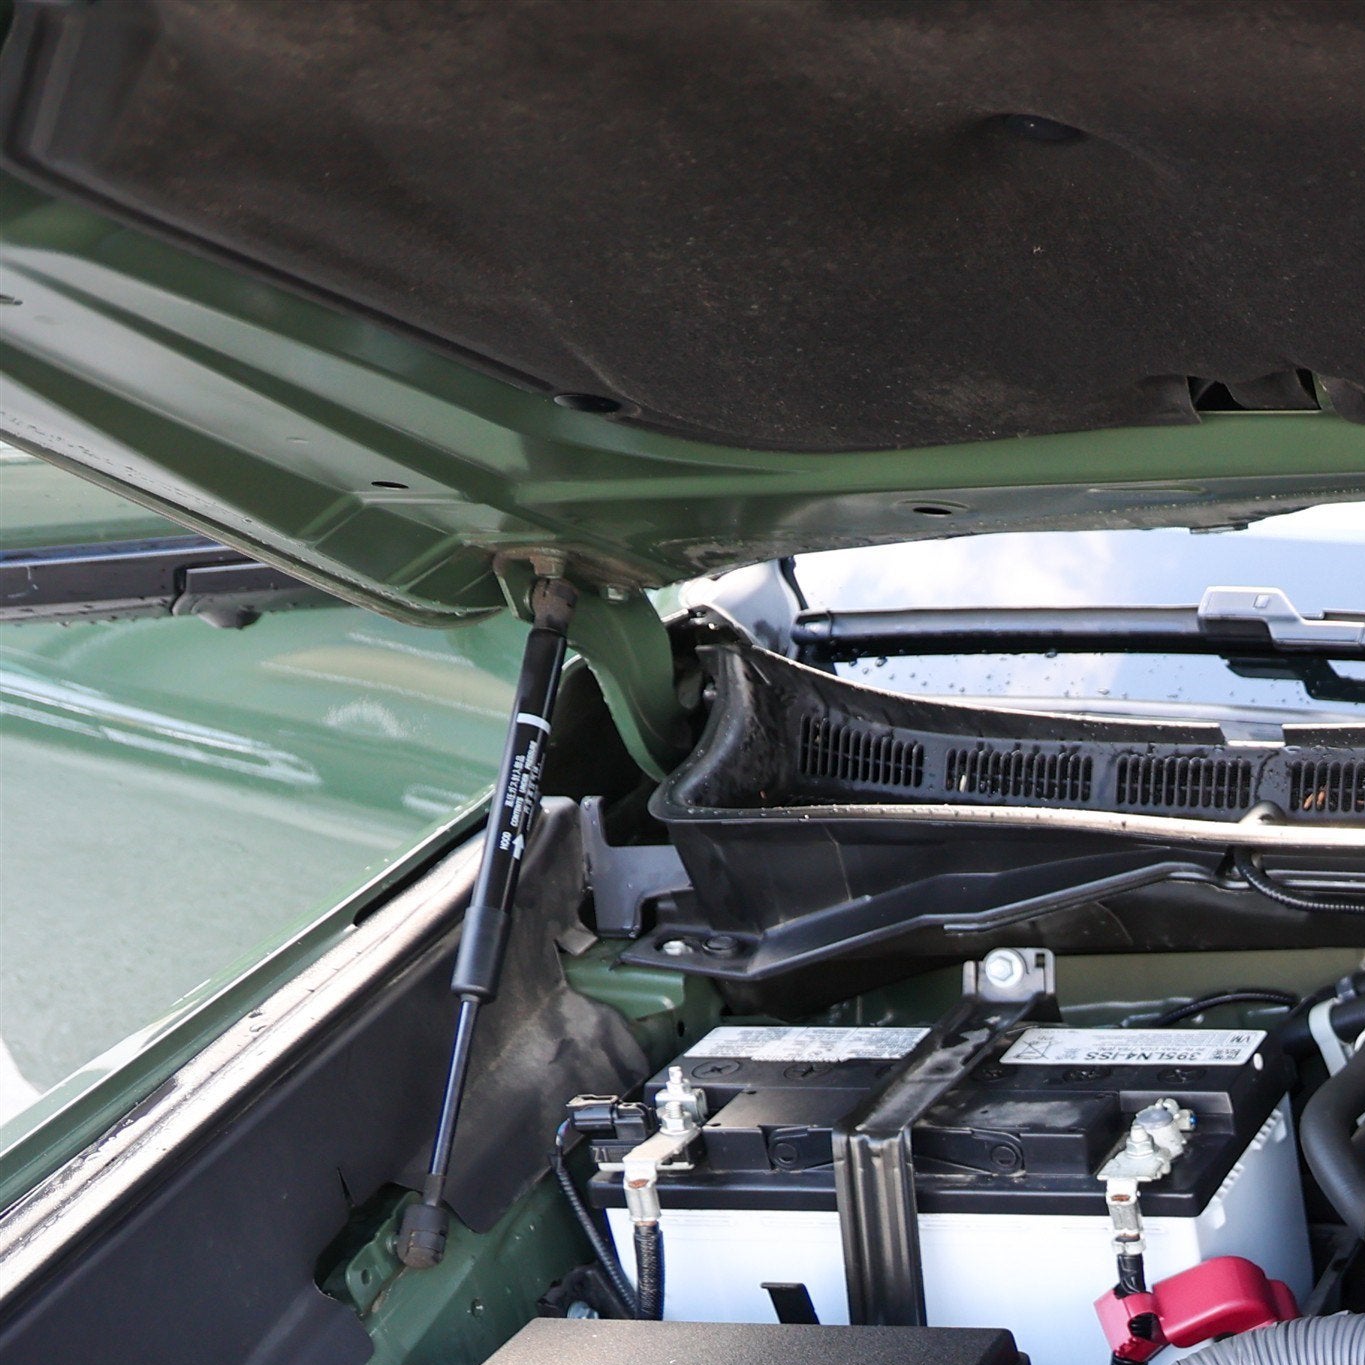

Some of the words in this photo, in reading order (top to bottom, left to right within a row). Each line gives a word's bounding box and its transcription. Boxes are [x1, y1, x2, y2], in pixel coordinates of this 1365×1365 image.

[509, 797, 524, 826] CONTENTS
[518, 773, 530, 796] UNDER
[525, 741, 538, 771] PRESSURE
[499, 831, 513, 851] HOOD
